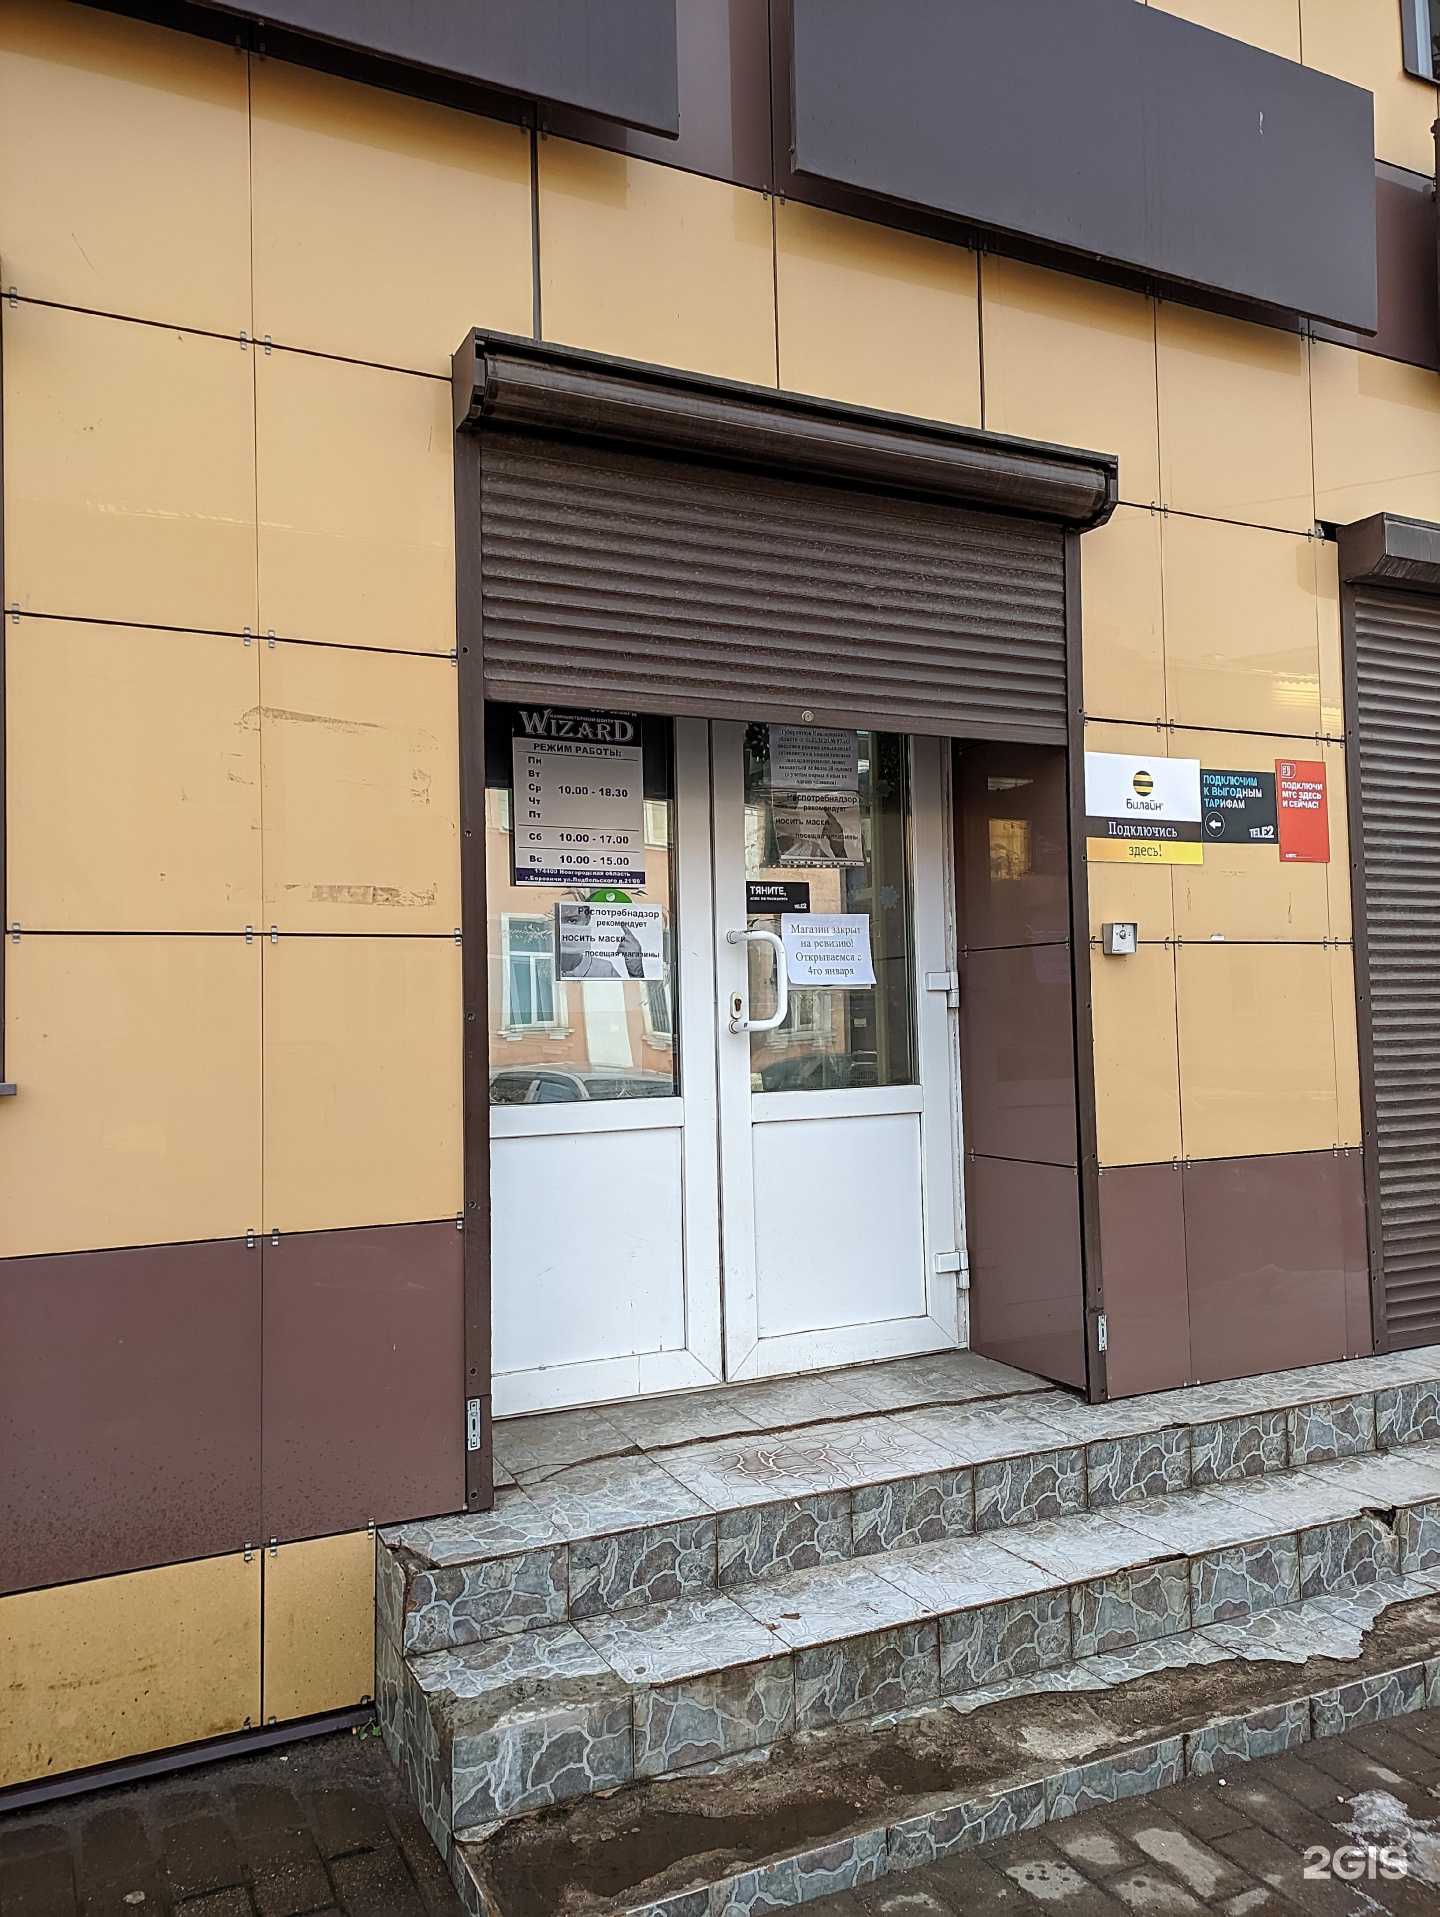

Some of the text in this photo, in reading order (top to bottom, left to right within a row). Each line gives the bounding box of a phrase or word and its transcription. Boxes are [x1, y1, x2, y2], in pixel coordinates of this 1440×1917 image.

[533, 743, 622, 757] РЕЖИМ РАБОТЫ:
[528, 756, 542, 765] Пн
[528, 770, 540, 778] Вт
[1203, 775, 1258, 787] ПОДКЛЮЧИМ
[528, 783, 542, 793] Ср
[558, 786, 589, 795] 10.00
[599, 788, 628, 798] 18.30
[1281, 782, 1323, 791] ПОДКЛЮЧИ
[1204, 787, 1262, 798] К ВЫГОДНЫМ
[1282, 791, 1322, 800] МТС ЗДЕСЬ
[528, 797, 541, 805] Чт
[1204, 799, 1246, 809] ТАРИФАМ
[1289, 799, 1319, 808] СЕЙЧАС!
[528, 810, 541, 818] Пт
[1108, 821, 1178, 837] Подключись
[1249, 825, 1275, 838] TELE2
[529, 833, 542, 841] Сб
[559, 833, 589, 843] 10.00
[600, 835, 629, 844] 17.00
[1129, 845, 1162, 857] здесь!
[529, 855, 542, 863] Вс
[560, 855, 590, 864] 10.00
[600, 857, 629, 866] 15.00
[578, 907, 660, 918] Роспотребнадзор
[596, 920, 648, 928] рекомендует
[791, 924, 861, 935] Магазин закрыт
[562, 934, 626, 943] носить маски
[814, 939, 854, 949] ревизию!
[795, 952, 855, 962] Открываемся
[808, 966, 855, 977] 4го января
